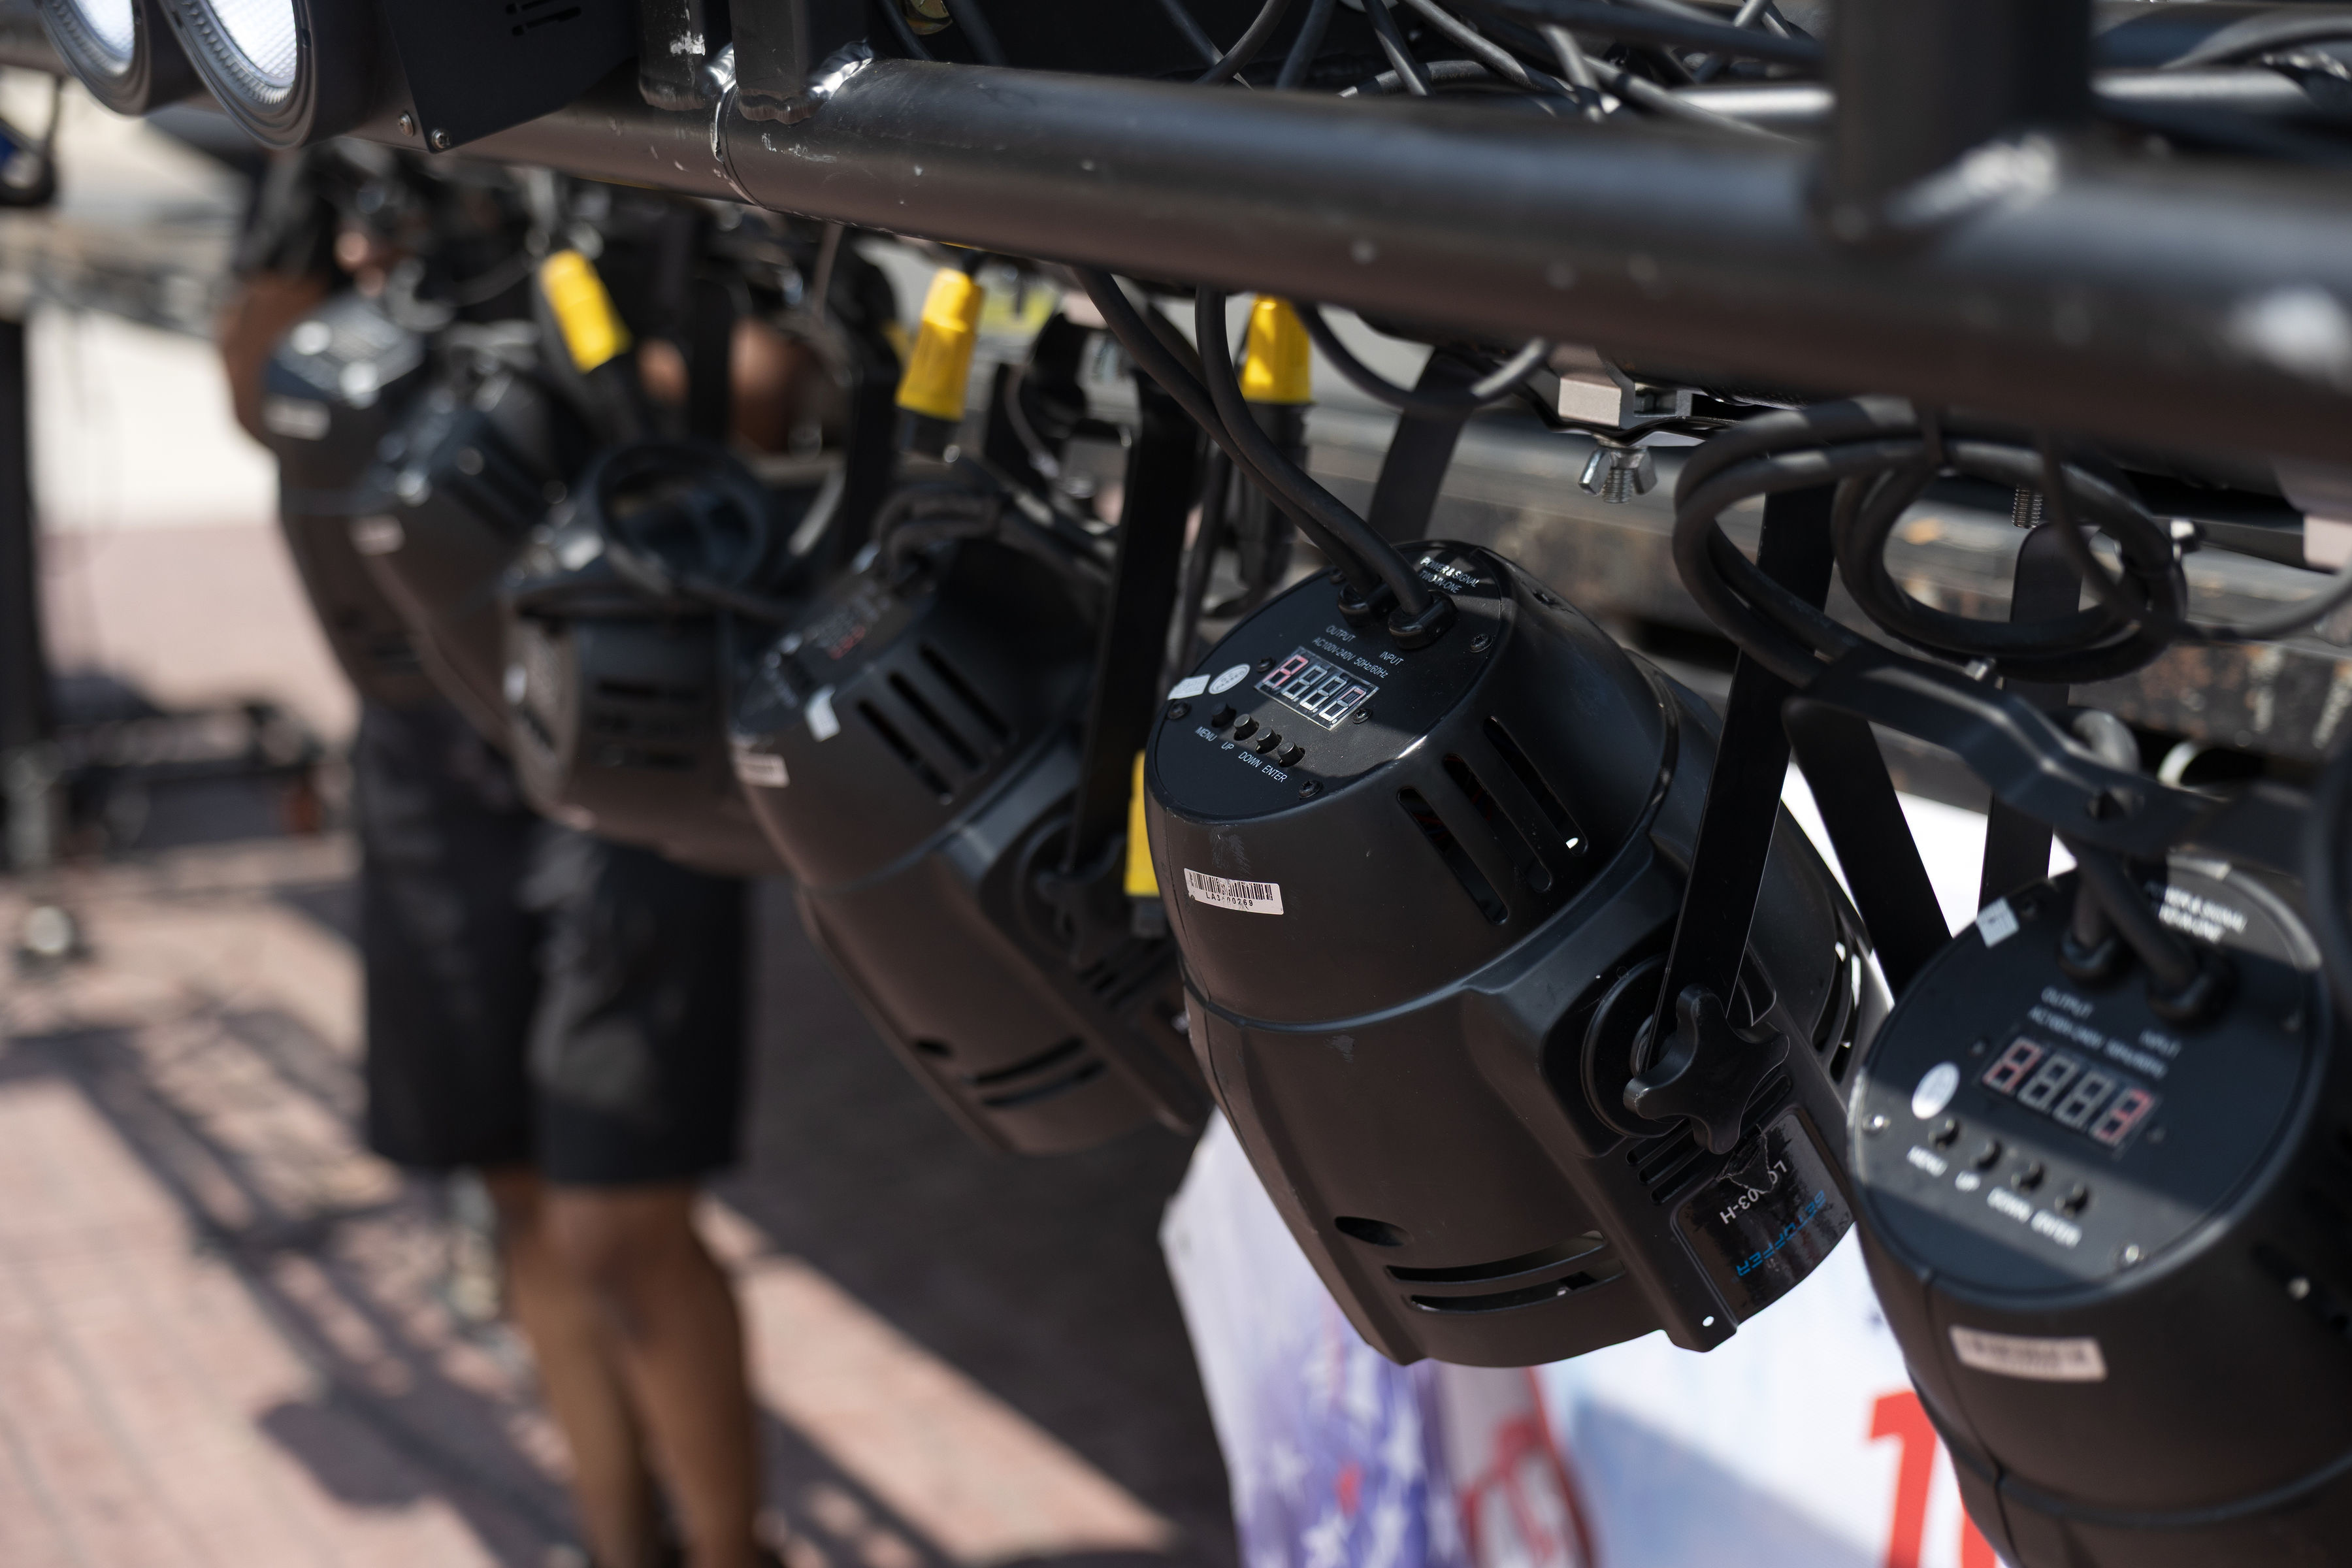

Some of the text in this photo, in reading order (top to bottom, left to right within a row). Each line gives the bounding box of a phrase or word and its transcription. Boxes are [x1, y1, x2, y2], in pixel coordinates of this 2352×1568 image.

[1326, 625, 1356, 642] OUTPUT
[1354, 657, 1388, 679] 50Hz/60Hz
[1379, 651, 1404, 666] INPUT
[1195, 727, 1288, 783] MENU UP DOWN ENTER
